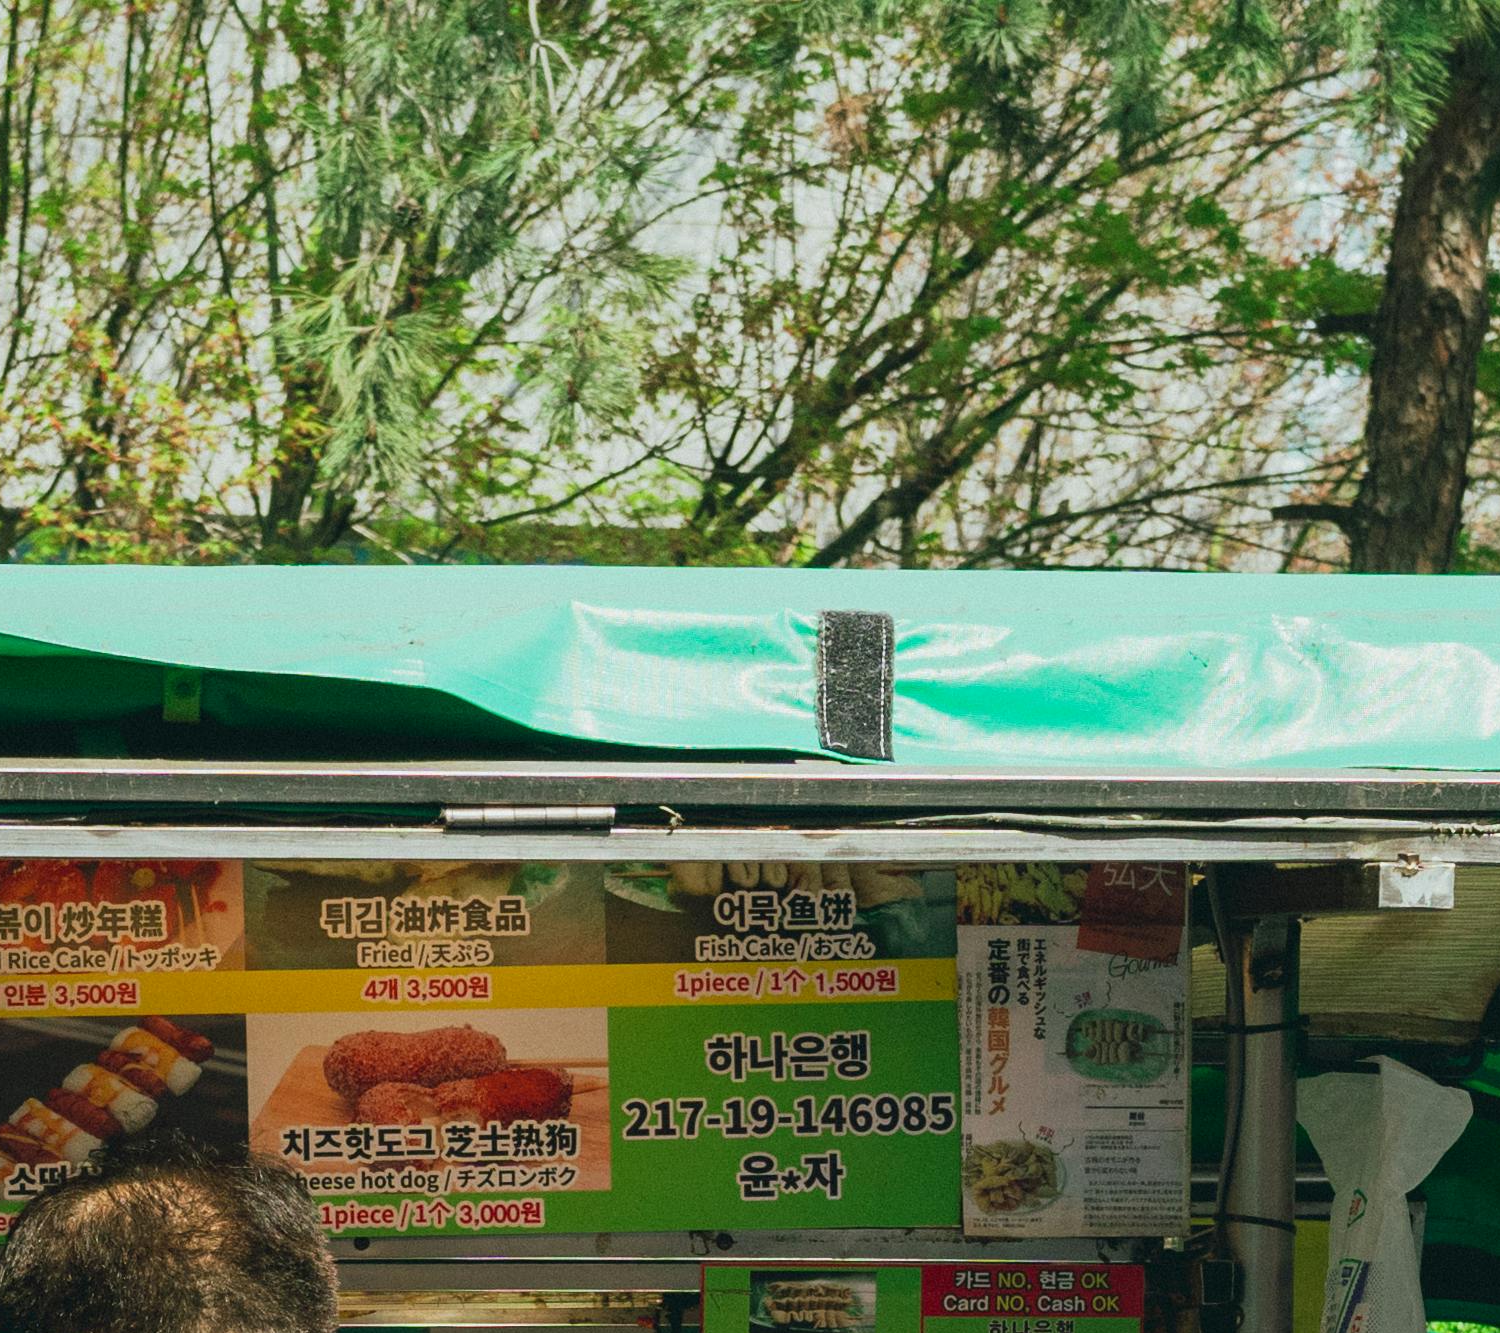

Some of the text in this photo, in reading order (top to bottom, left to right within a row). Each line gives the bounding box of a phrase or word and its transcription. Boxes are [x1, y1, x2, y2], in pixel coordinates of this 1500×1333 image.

[61, 903, 165, 940] 炒年糕
[322, 900, 528, 937] 튀김 油炸食品
[715, 893, 853, 929] 어묵 鱼饼
[8, 947, 45, 969] Rice
[50, 947, 106, 969] Cake
[124, 946, 218, 969] トッポッキ
[361, 943, 413, 964] Fried
[698, 935, 874, 959] Fish Cake おでん
[676, 969, 897, 997] 1piece 1个 1,500원
[1016, 938, 1031, 1006] 街で食べる
[55, 982, 138, 1007] 3,500원
[363, 976, 490, 1002] 4개 3,500원
[987, 938, 1010, 1116] 定番の韓国グルメ
[706, 1034, 870, 1082] 하나은행
[625, 1096, 953, 1140] 217-19-146985
[283, 1124, 578, 1162] 치즈핫도그 芝士热狗
[295, 1170, 356, 1192] heese
[362, 1171, 395, 1192] hot
[399, 1171, 440, 1196] dog
[320, 1202, 543, 1230] 1piece 1个 3,000원
[955, 1270, 993, 1290] 카드
[1038, 1270, 1075, 1291] 현금
[1080, 1271, 1110, 1290] OK
[943, 1294, 989, 1312] Card
[1037, 1294, 1086, 1312] Cash
[1091, 1295, 1120, 1312] OK
